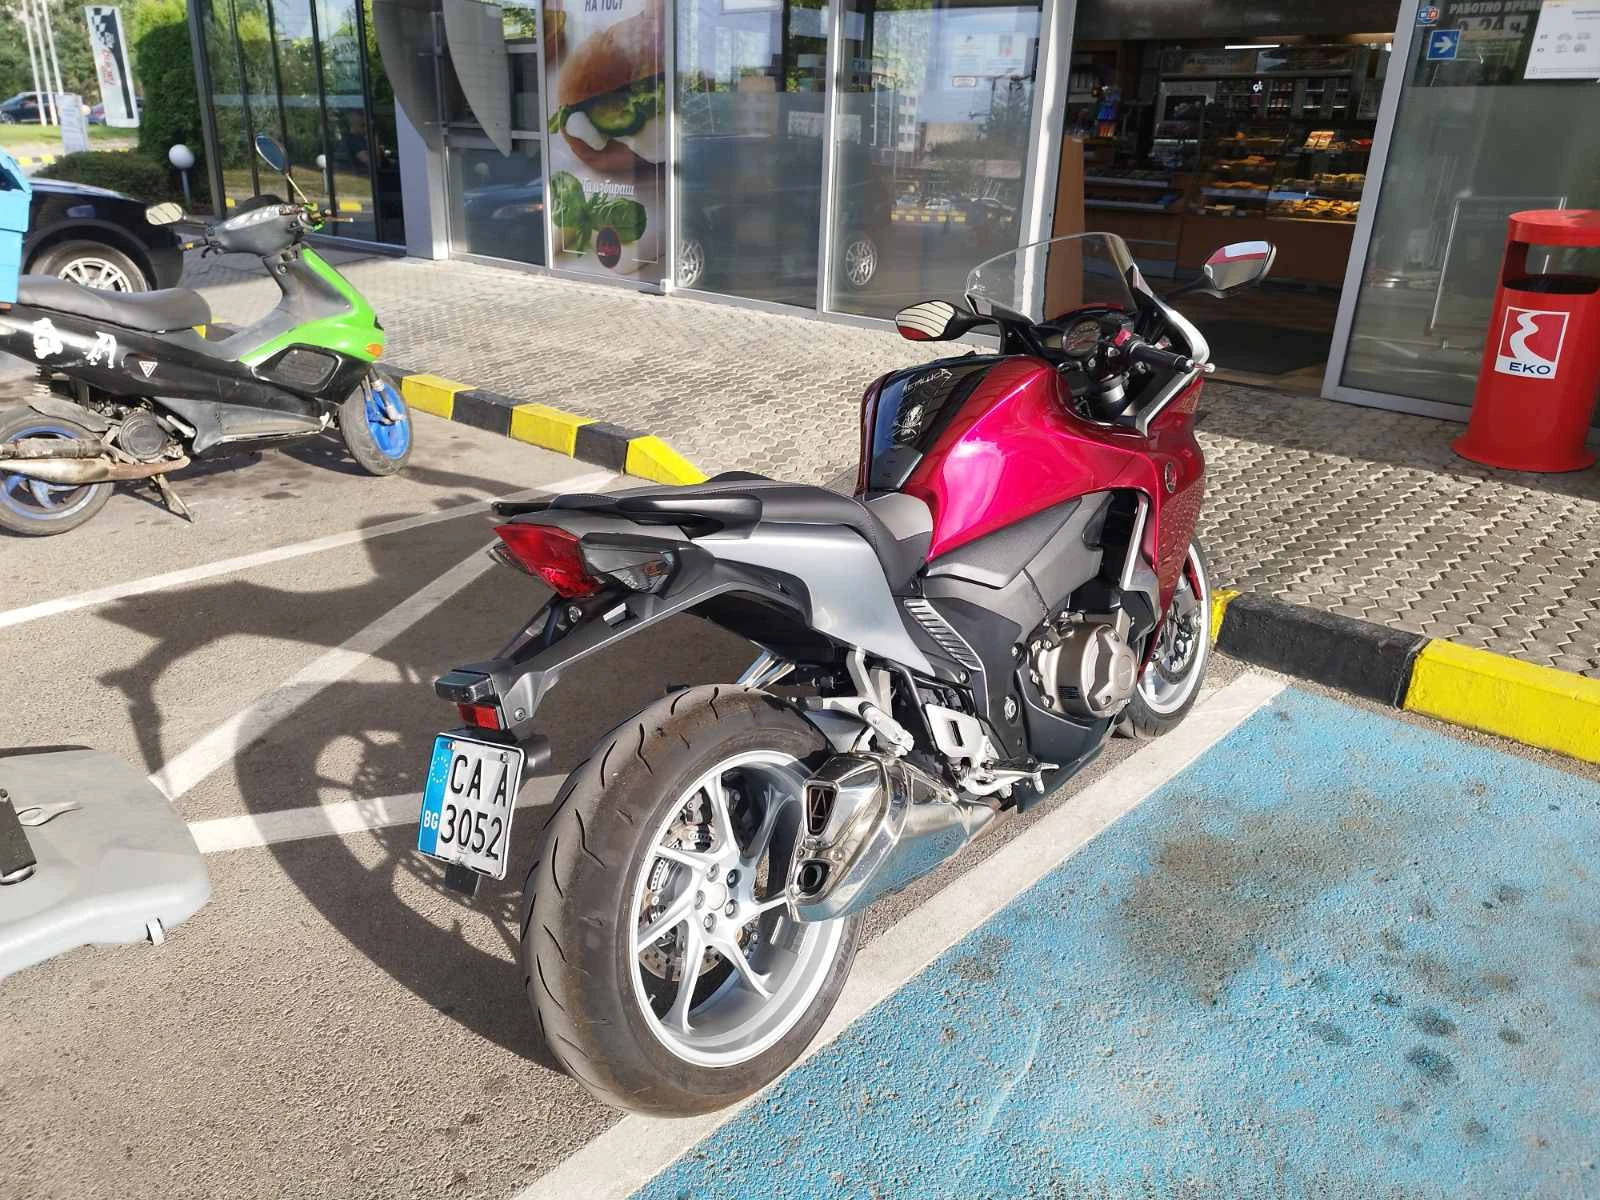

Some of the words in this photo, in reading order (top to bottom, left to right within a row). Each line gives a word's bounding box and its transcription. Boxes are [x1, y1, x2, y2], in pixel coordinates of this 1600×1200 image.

[1448, 1, 1502, 15] РАБОТНО
[1503, 0, 1543, 13] ВРЕМ
[1509, 361, 1551, 375] EKO
[450, 754, 482, 800] CA
[493, 764, 509, 808] A
[423, 810, 440, 830] BG
[440, 804, 503, 860] 3052
